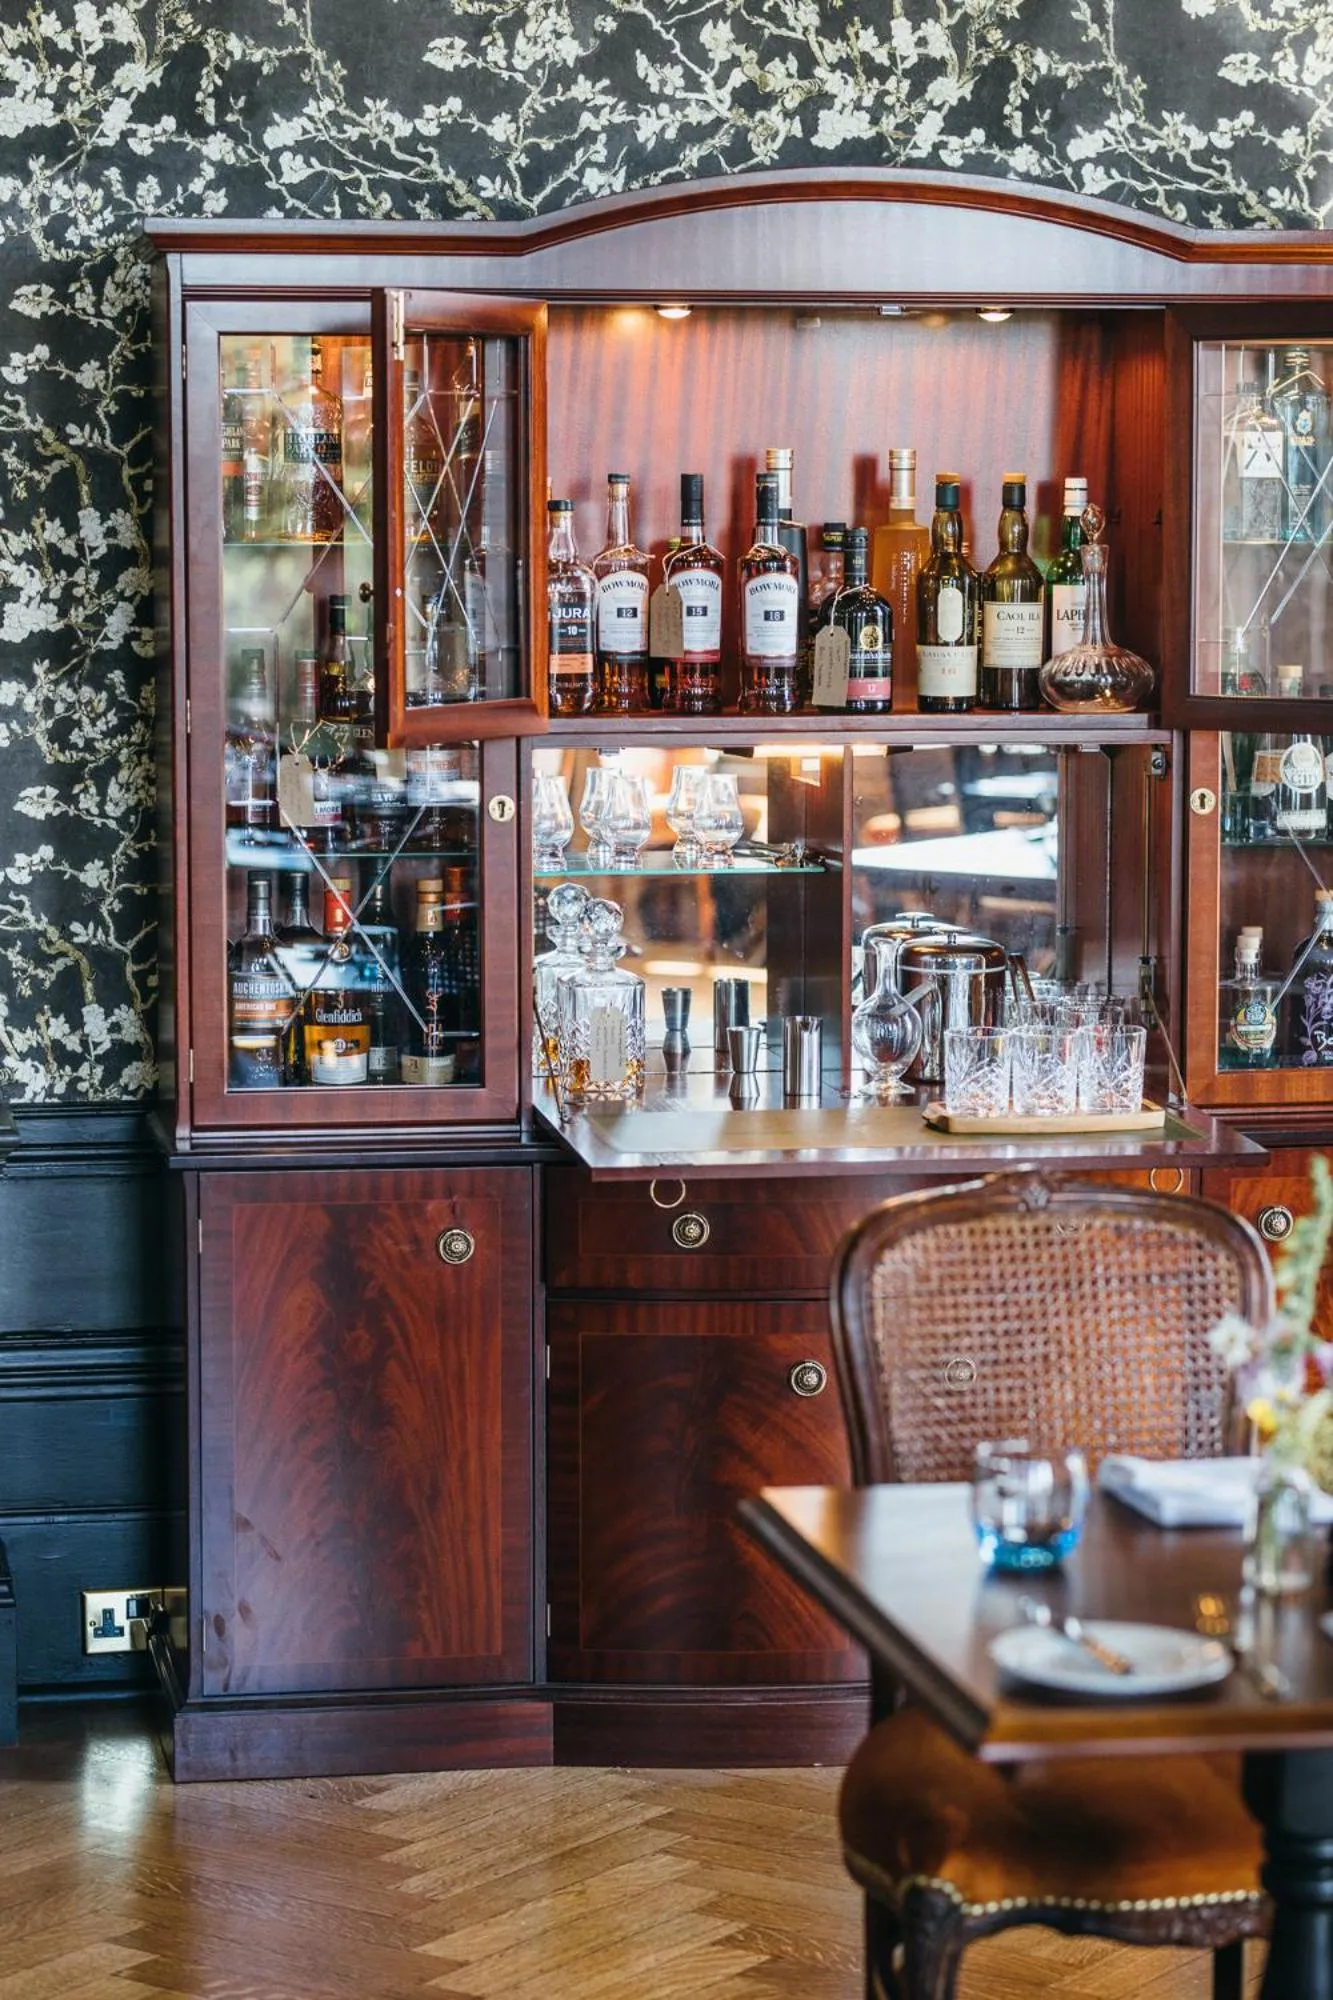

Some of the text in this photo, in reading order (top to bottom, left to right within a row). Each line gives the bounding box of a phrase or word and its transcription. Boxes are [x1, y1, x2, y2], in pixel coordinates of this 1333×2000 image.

[602, 580, 647, 593] BOWMORE
[749, 582, 796, 595] BOWMORE
[552, 607, 591, 618] JURA
[997, 611, 1024, 621] CAOL
[568, 626, 578, 636] 10
[316, 1008, 364, 1023] Glenfiddich
